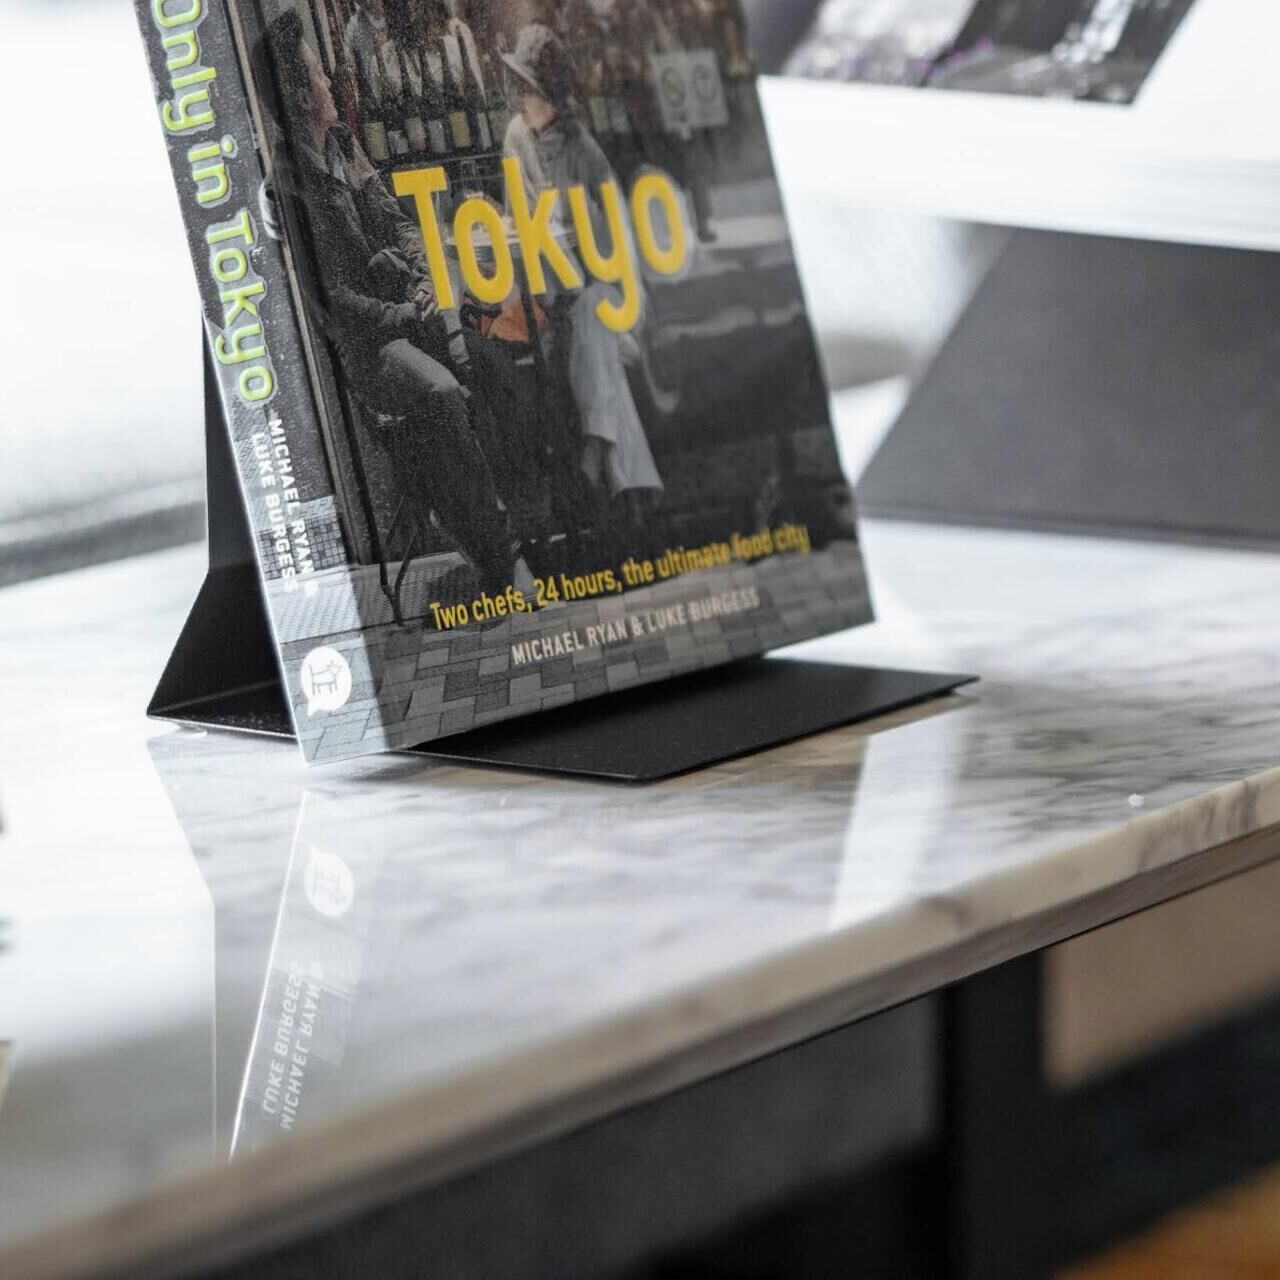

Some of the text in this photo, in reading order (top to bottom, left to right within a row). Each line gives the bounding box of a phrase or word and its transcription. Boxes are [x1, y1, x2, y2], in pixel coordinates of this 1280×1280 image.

[187, 142, 234, 205] in
[393, 159, 688, 332] Tokyo
[206, 210, 274, 402] Tokyo
[252, 432, 298, 593] LUKE BURGESS
[269, 418, 301, 516] MICHAEL
[292, 519, 315, 574] RYAN
[430, 522, 812, 632] Two chefs, 24 hours, the ultimate food city
[511, 586, 760, 666] MICHAEL RYAN & LUKE BURGESS
